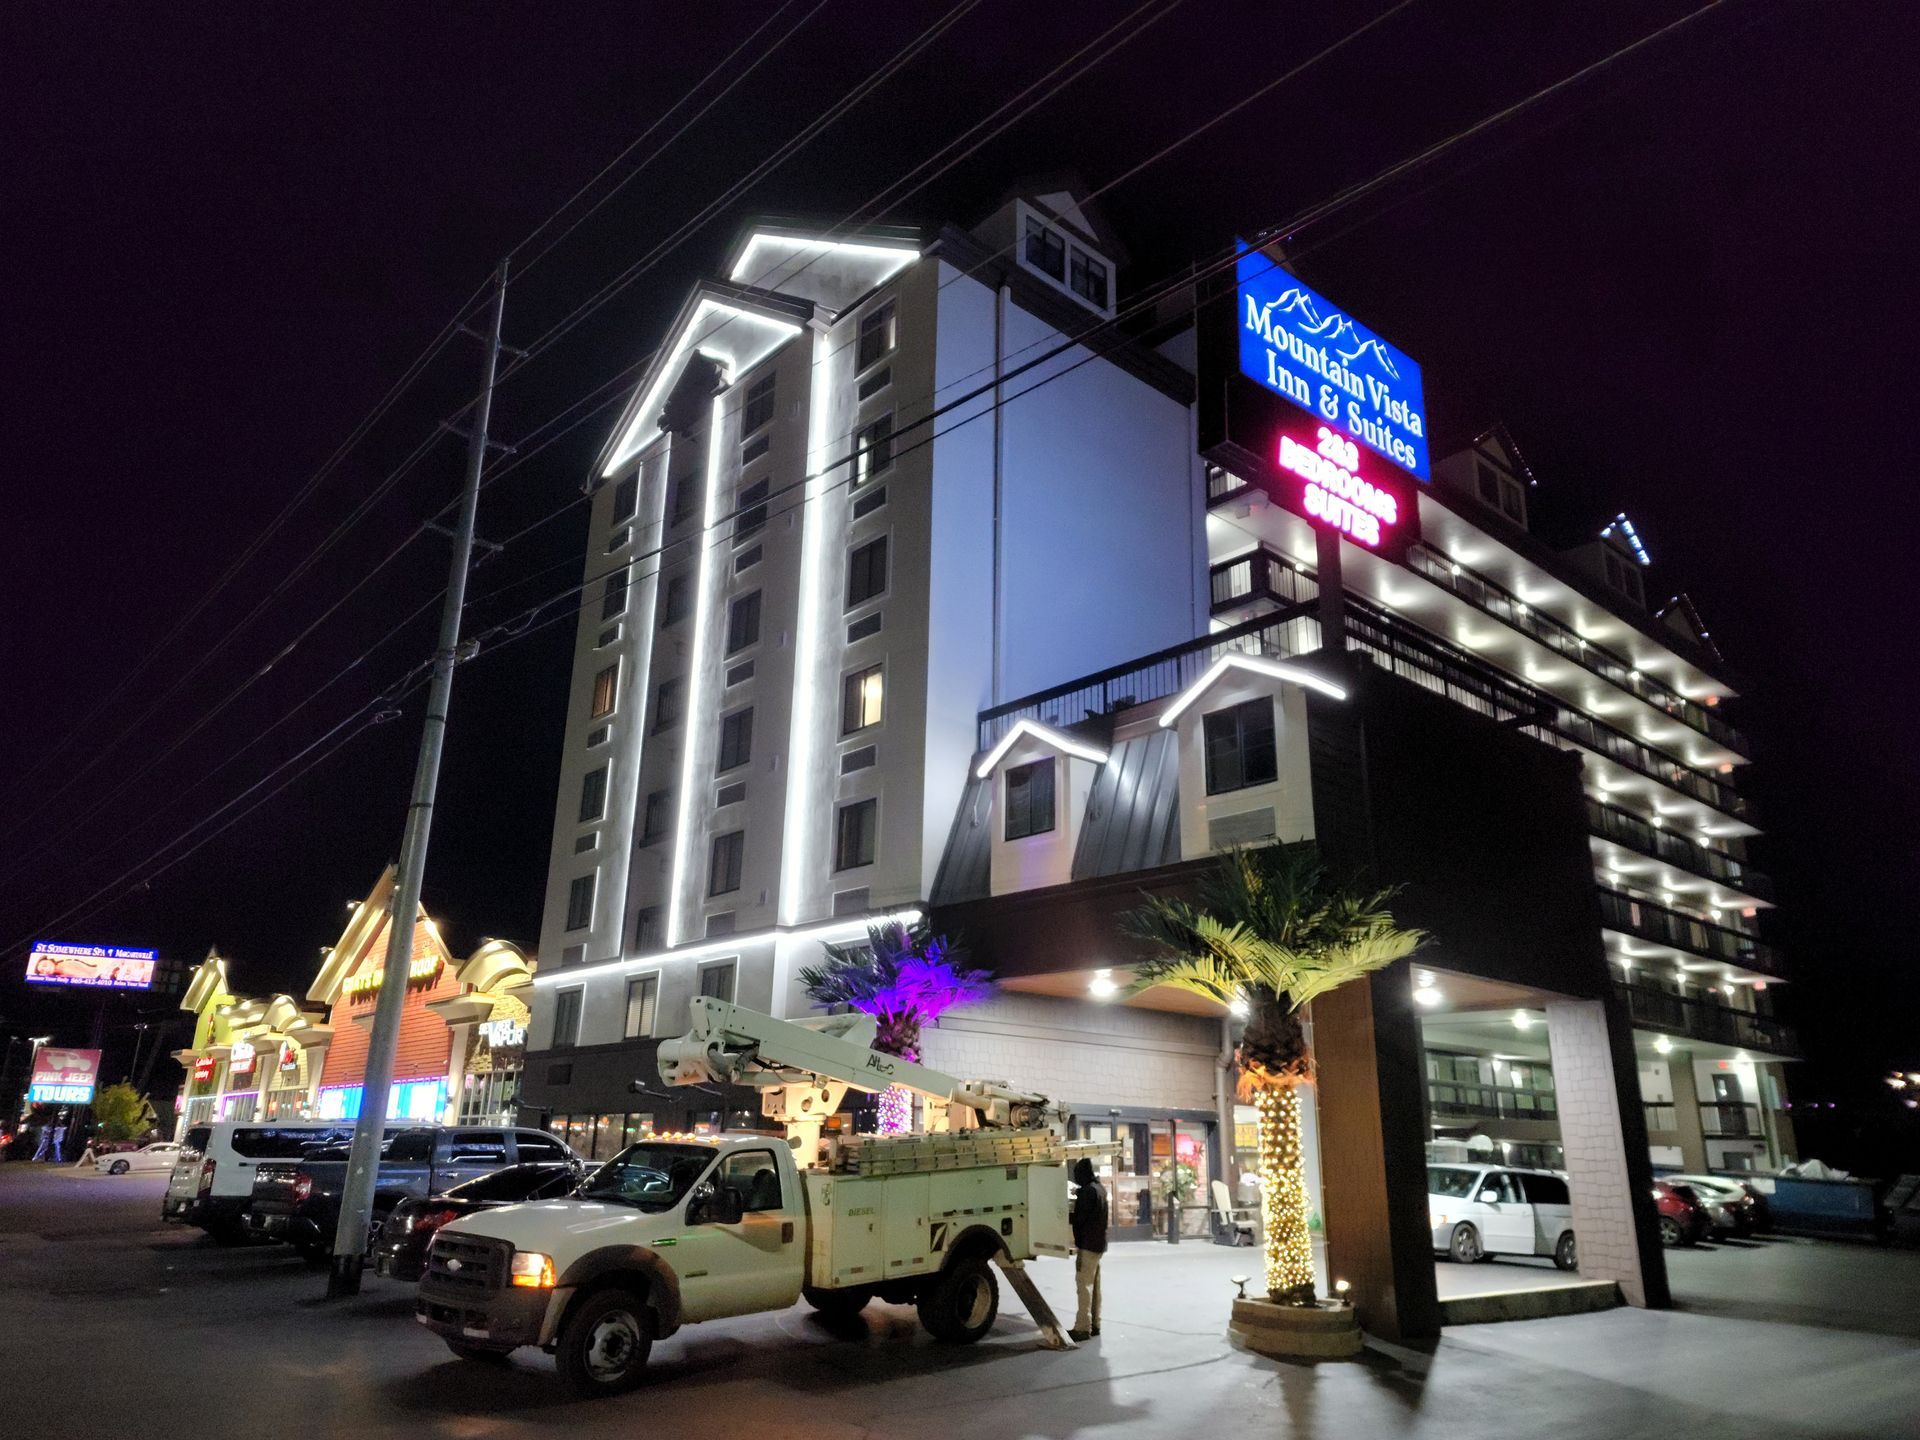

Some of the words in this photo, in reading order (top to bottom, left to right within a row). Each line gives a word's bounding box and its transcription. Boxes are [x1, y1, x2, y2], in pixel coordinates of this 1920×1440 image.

[1245, 294, 1366, 401] Mountain
[1366, 374, 1423, 437] Vista
[1266, 348, 1311, 406] Inn
[1319, 384, 1339, 419] &
[1348, 401, 1417, 469] Suites
[1279, 435, 1397, 525] BEDROOMS
[1303, 482, 1380, 546] SUITES
[47, 943, 92, 955] SOMEWHERE
[92, 947, 105, 957] SPA
[33, 1085, 91, 1102] TOURS
[35, 1071, 64, 1082] PINK
[65, 1072, 94, 1083] JEEP
[848, 1207, 877, 1217] DIESEL
